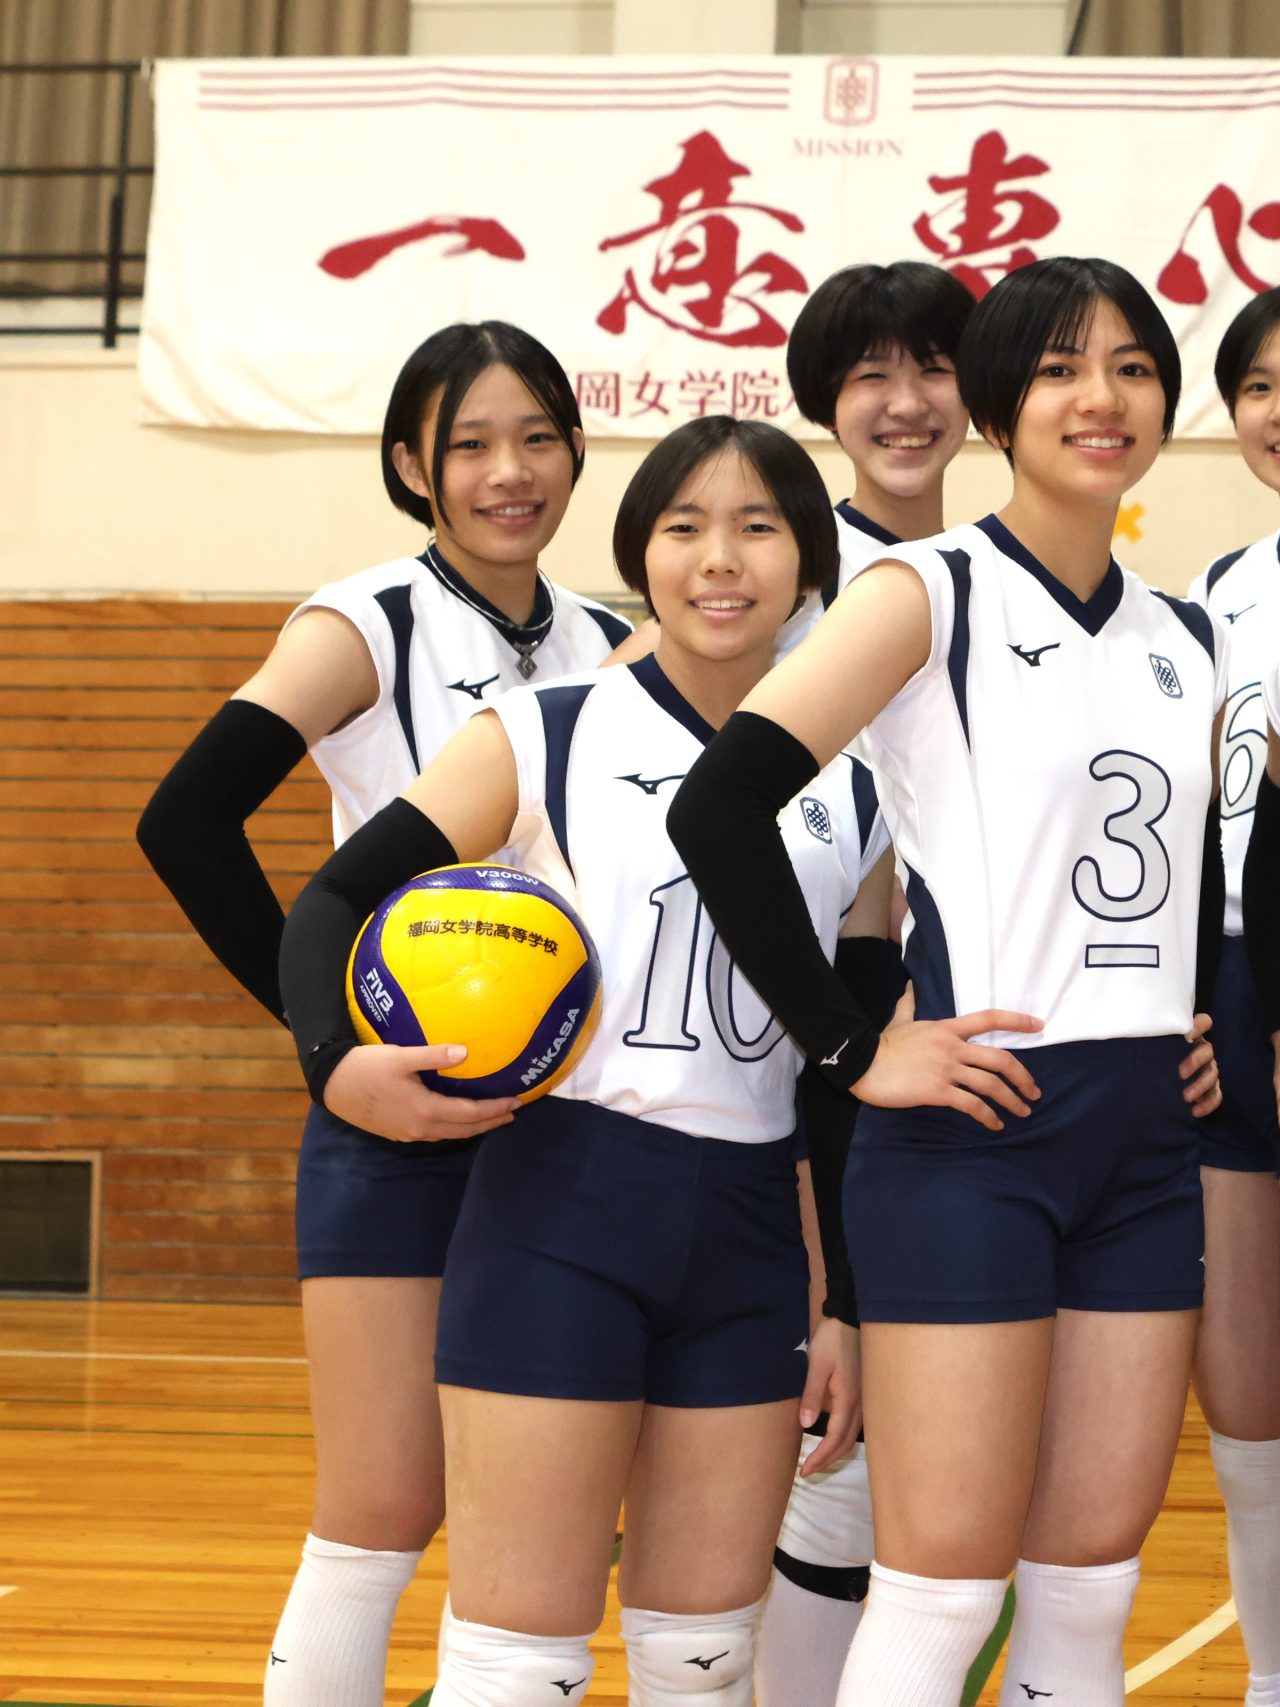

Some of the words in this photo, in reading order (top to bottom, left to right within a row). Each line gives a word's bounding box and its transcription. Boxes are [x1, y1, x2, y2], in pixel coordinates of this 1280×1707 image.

[792, 138, 904, 158] MISSION
[566, 369, 796, 418] 岡女学院
[1219, 681, 1269, 820] 6
[1071, 748, 1172, 923] 3
[475, 869, 540, 886] V300W
[407, 918, 560, 957] 福岡女学院高等学校
[366, 967, 394, 1013] FIVB
[622, 872, 788, 1064] 10
[359, 984, 382, 1022] APPROVED
[519, 1007, 581, 1087] MIKASA
